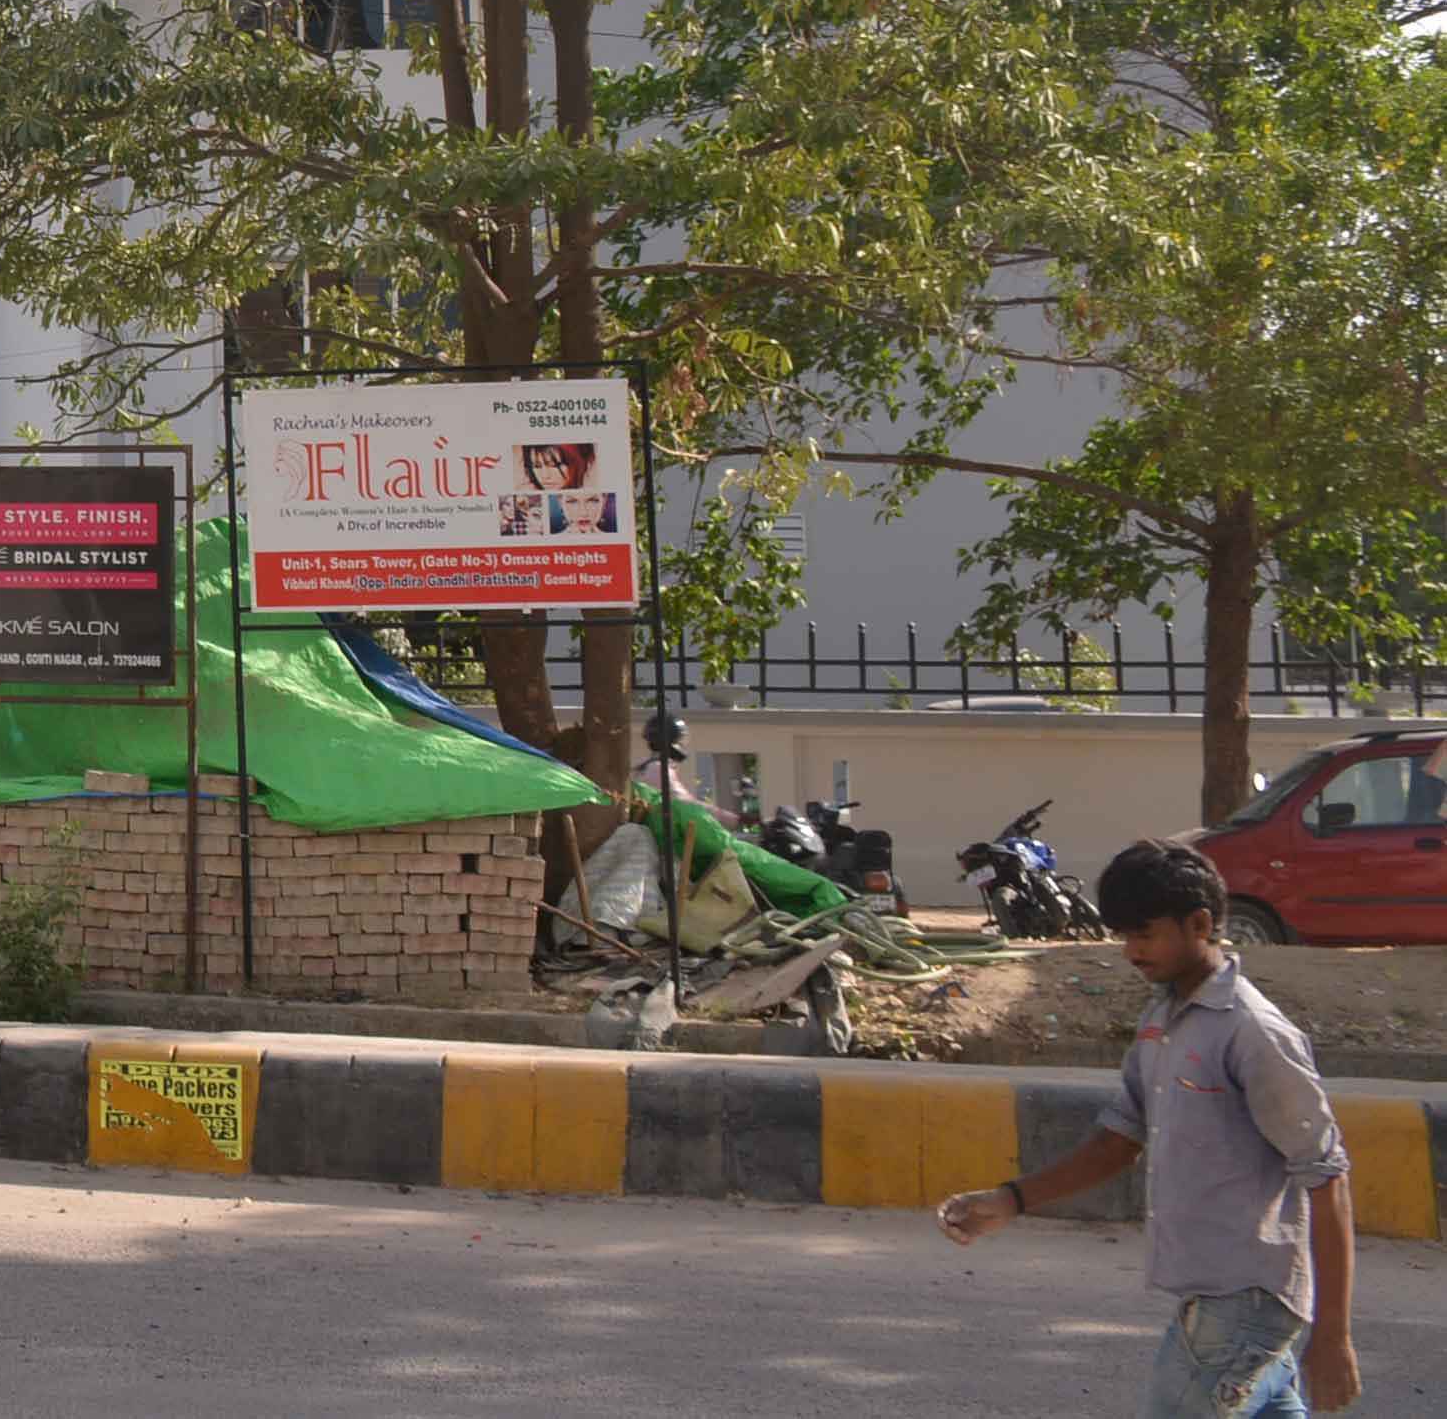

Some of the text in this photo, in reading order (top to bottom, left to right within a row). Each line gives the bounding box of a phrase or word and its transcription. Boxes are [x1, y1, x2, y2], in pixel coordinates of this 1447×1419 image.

[273, 413, 433, 431] Rachna's Makeovers
[529, 414, 608, 428] 9838144144
[302, 433, 502, 501] Flair
[4, 509, 70, 524] STYLE.
[77, 509, 148, 524] FINISH.
[337, 521, 345, 531] A
[385, 517, 446, 530] Incredible
[14, 551, 74, 565] BRIDAL
[80, 551, 148, 565] STYLIST
[329, 556, 369, 570] Sears
[372, 555, 417, 570] Tower,
[420, 554, 458, 569] (Gate
[502, 553, 550, 566] Omaxe
[554, 551, 608, 567] Heights
[282, 577, 317, 590] Vibhuti
[389, 574, 423, 589] Indira
[426, 573, 469, 588] Gandhi
[544, 573, 577, 586] Gomti
[579, 573, 613, 587] Nagar
[48, 620, 119, 636] SALON
[25, 653, 52, 665] GOMTI
[163, 1077, 237, 1100] Packers
